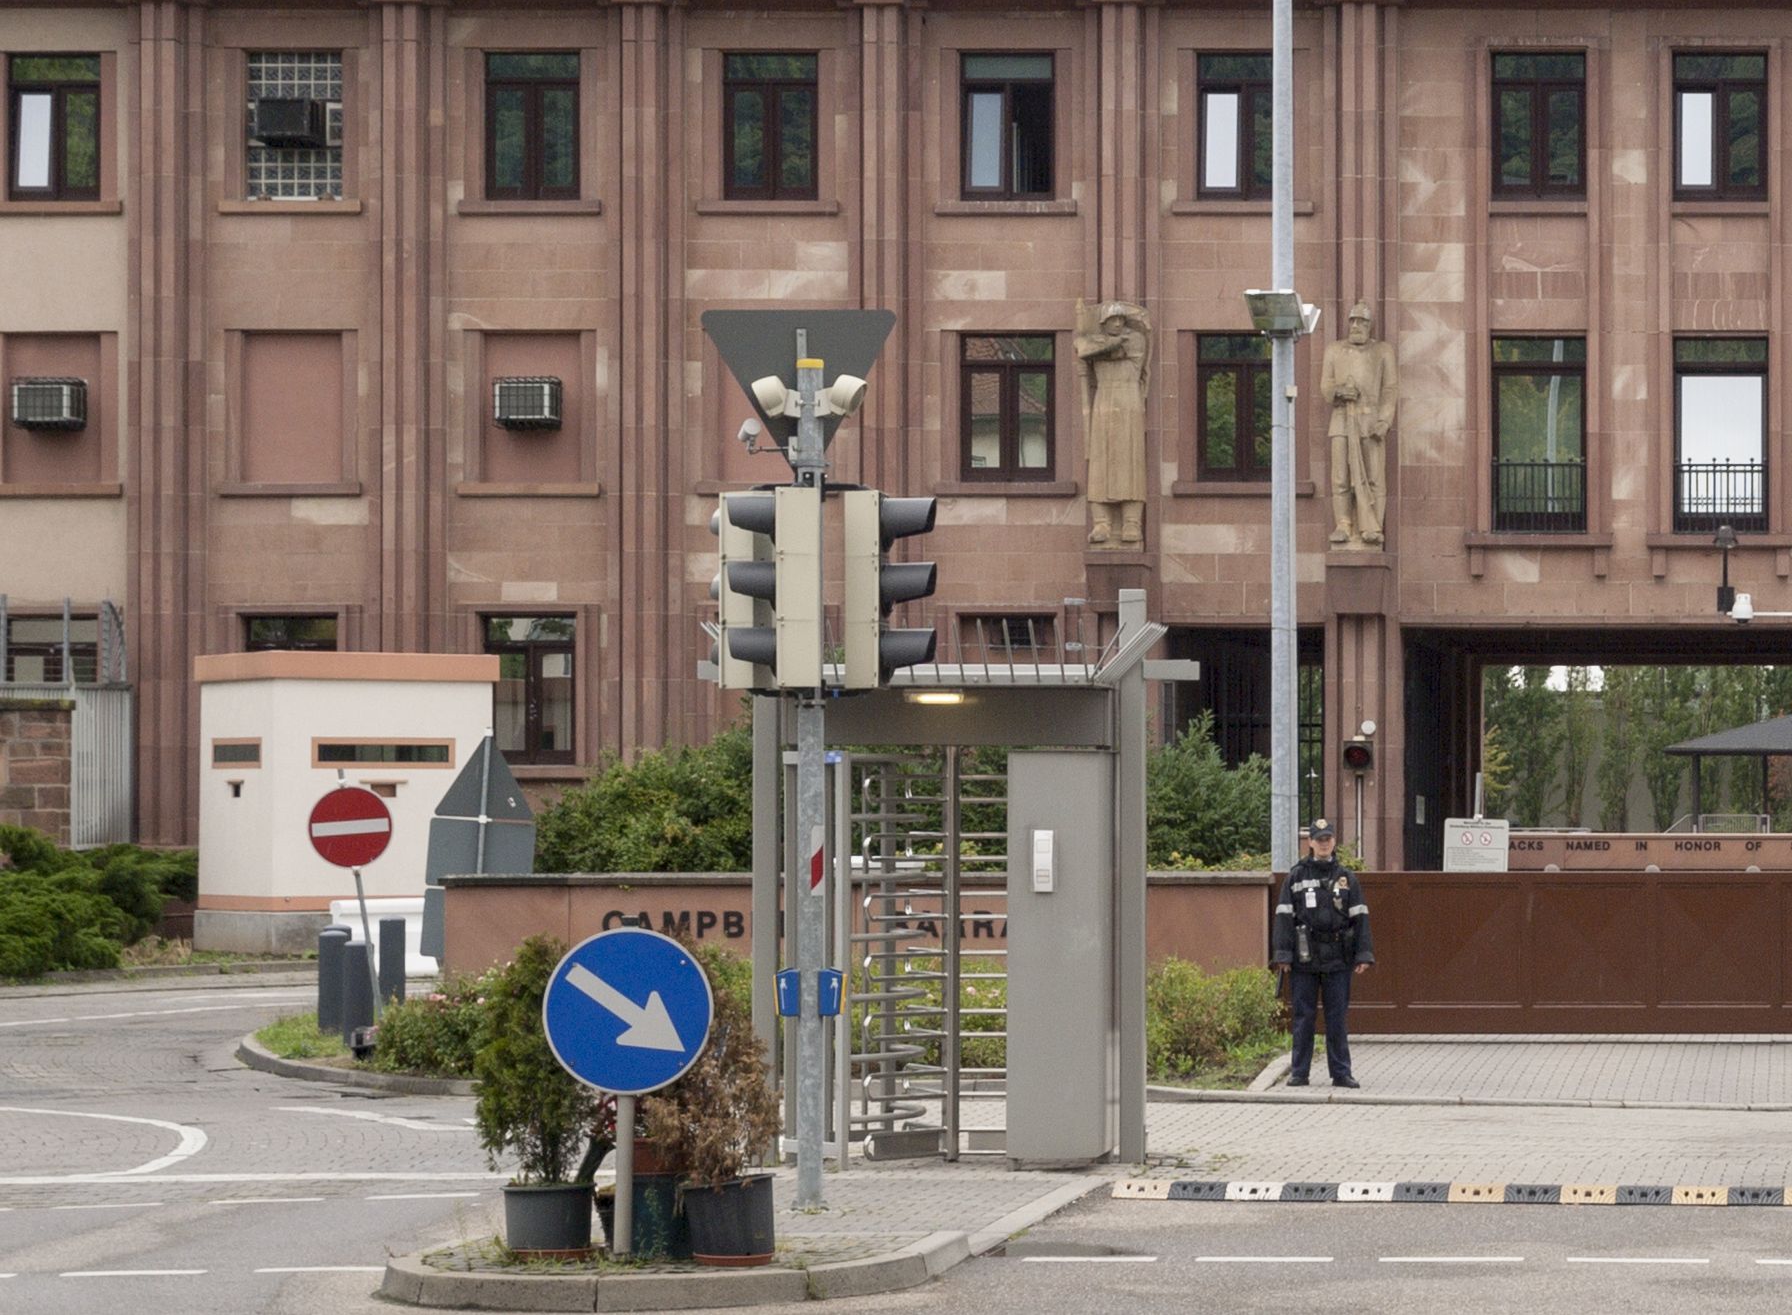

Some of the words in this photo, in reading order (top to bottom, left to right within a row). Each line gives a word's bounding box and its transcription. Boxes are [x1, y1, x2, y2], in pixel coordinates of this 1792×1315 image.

[1566, 841, 1611, 852] NAMED
[1635, 841, 1647, 852] IN
[1675, 841, 1722, 852] HONOR
[1745, 841, 1762, 852] OF
